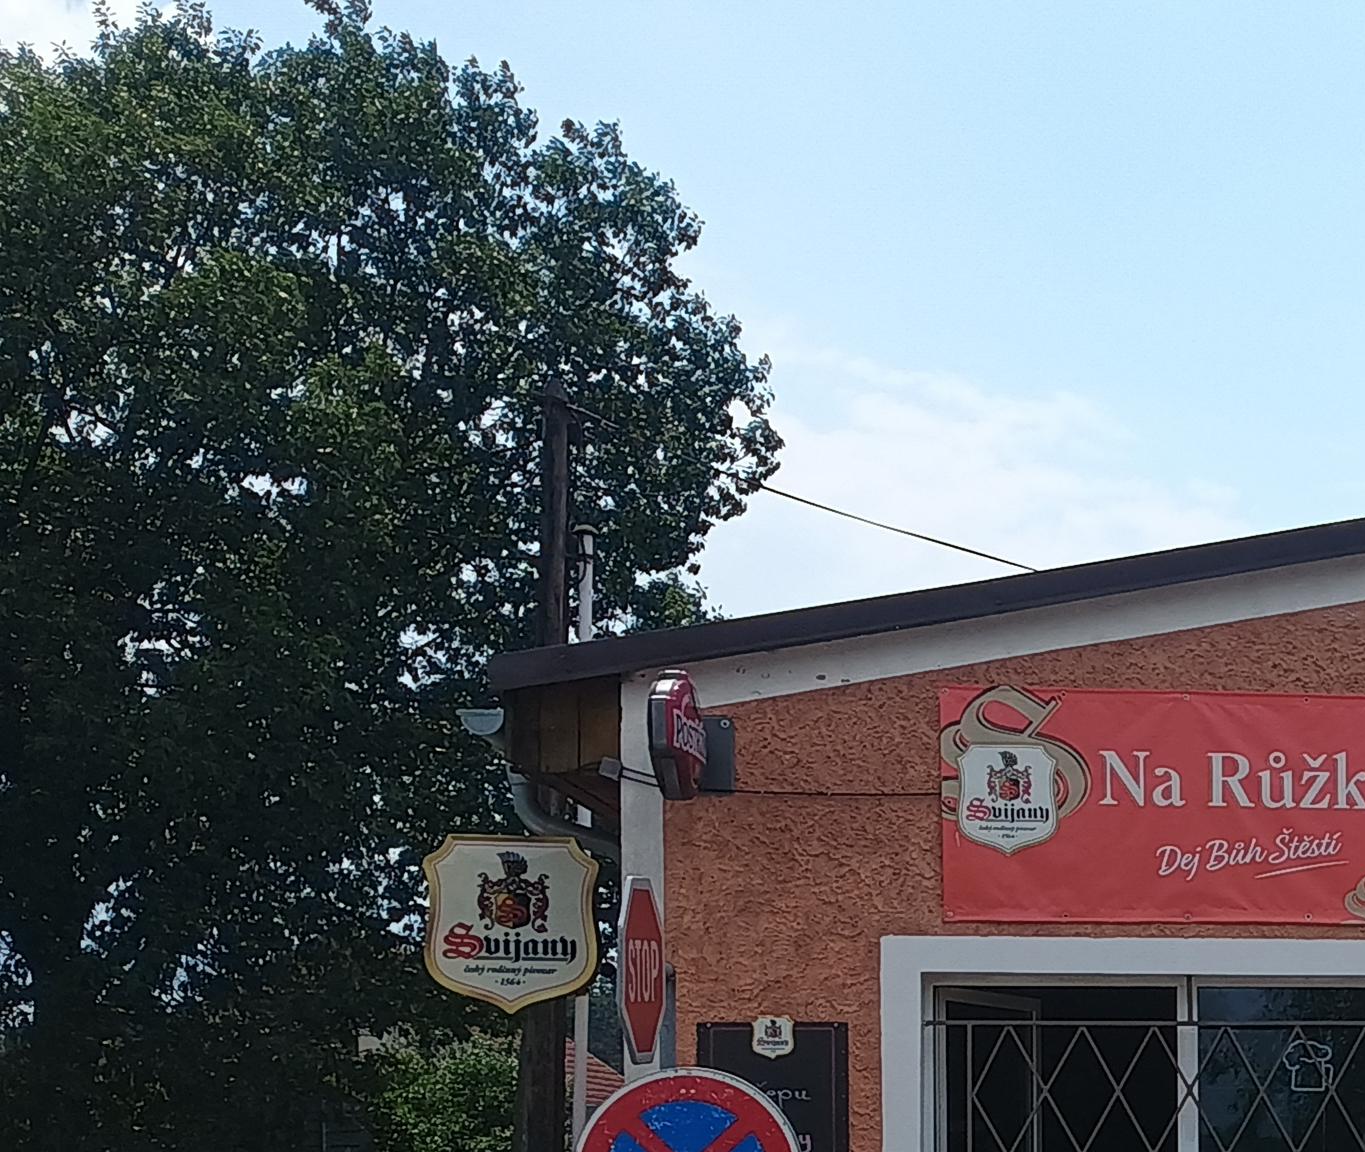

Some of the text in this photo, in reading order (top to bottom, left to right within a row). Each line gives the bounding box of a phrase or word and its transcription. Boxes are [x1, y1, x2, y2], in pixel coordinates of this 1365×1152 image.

[1098, 750, 1187, 807] Na
[966, 797, 1049, 824] Svijany
[1156, 828, 1342, 881] Dej Bůh Štěstí
[442, 922, 577, 965] Svijany
[628, 939, 659, 1002] STOP
